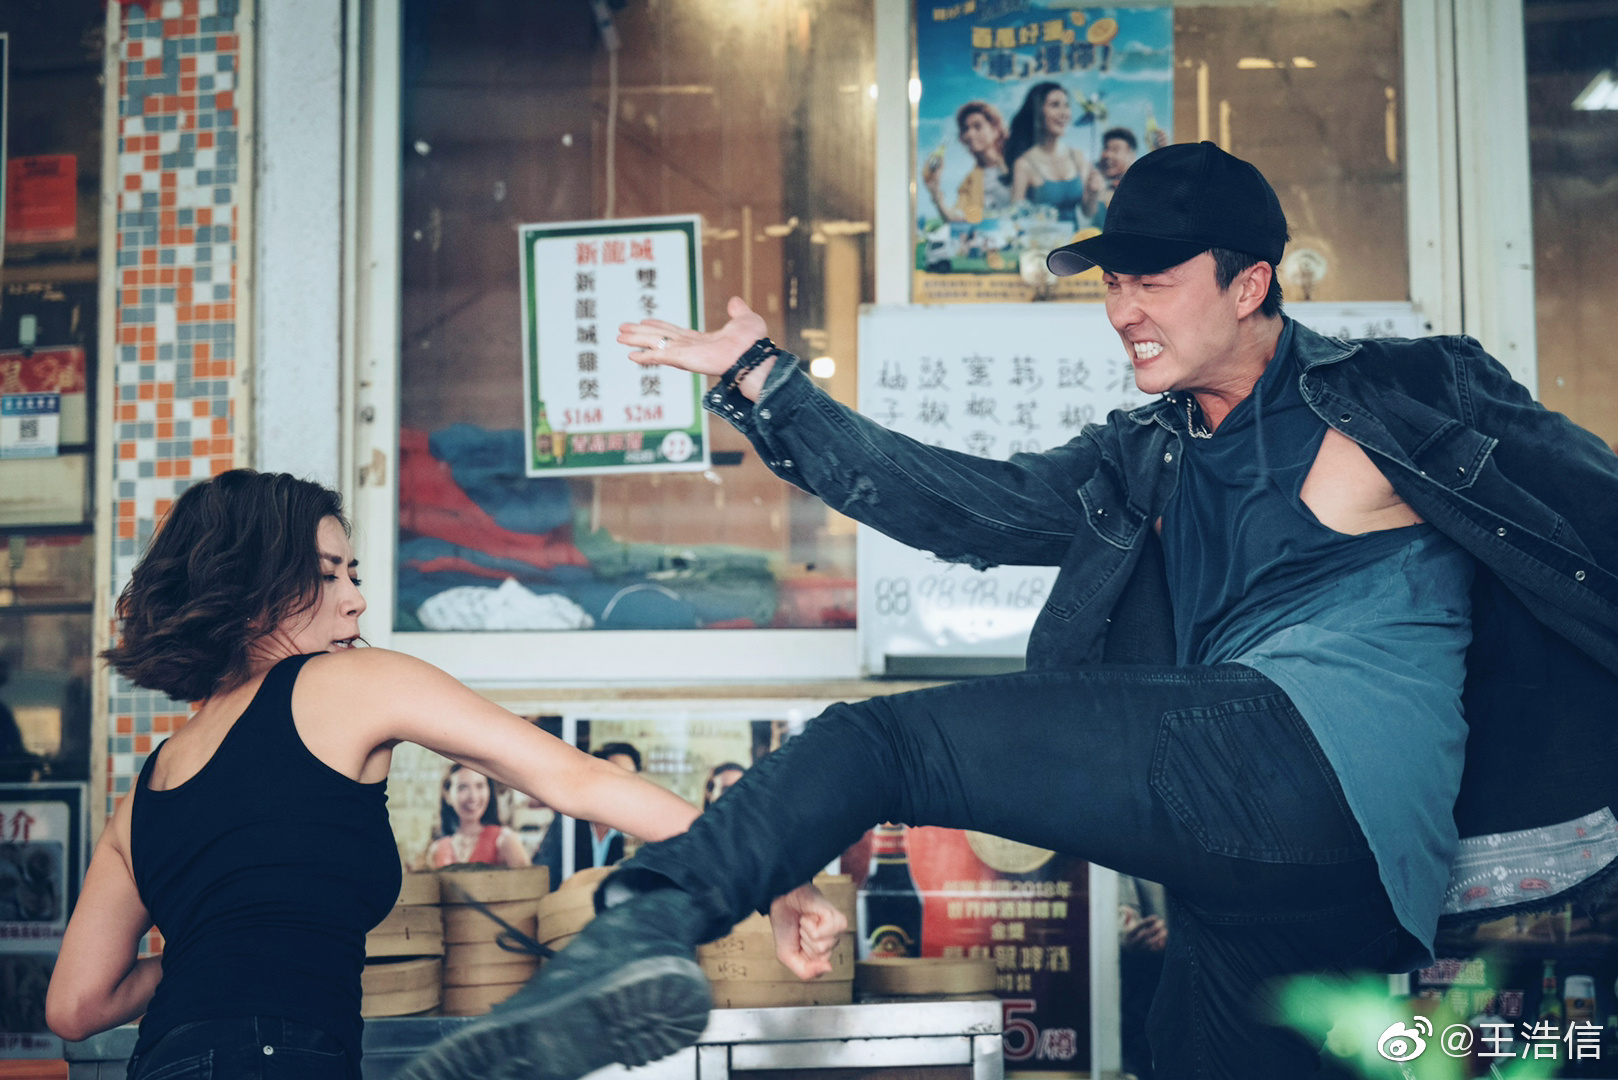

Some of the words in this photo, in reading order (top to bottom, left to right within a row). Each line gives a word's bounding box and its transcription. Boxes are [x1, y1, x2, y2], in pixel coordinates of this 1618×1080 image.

[576, 239, 655, 265] 新龍城
[637, 268, 661, 397] 雙冬煲
[564, 409, 603, 426] $168
[624, 405, 664, 423] $268
[874, 576, 912, 616] 88
[0, 807, 36, 843] 介
